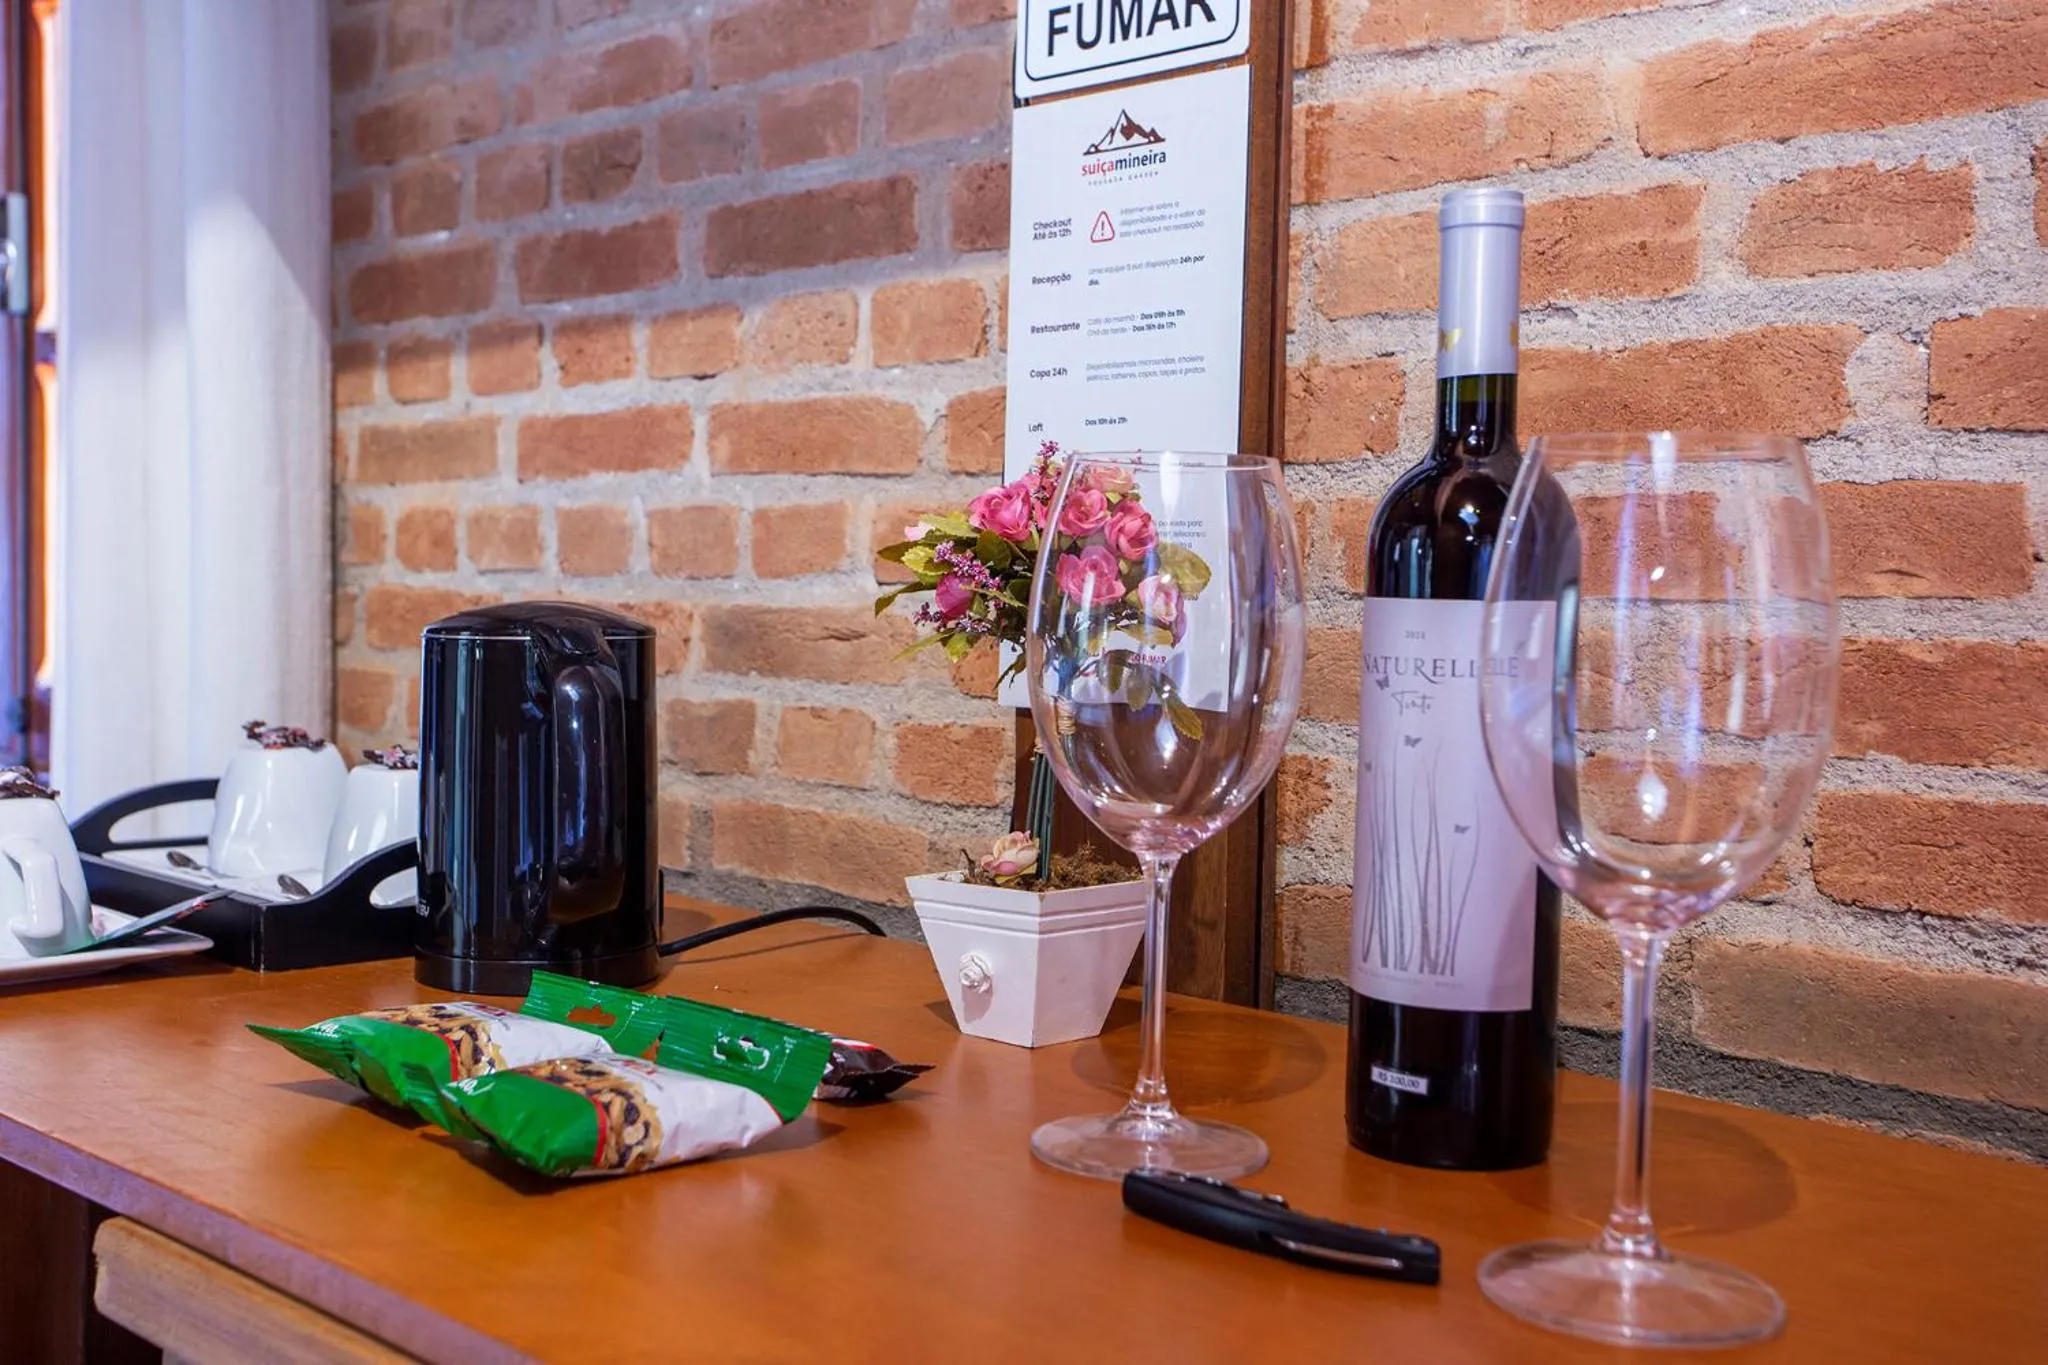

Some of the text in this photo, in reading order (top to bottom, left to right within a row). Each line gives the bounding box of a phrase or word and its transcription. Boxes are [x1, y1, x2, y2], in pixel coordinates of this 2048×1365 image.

[1048, 0, 1216, 57] FUMAR
[1082, 149, 1166, 176] suiçamineira
[1033, 218, 1072, 231] Checkout
[1032, 273, 1071, 286] Recepção
[1031, 322, 1081, 335] Restaurante
[1030, 367, 1068, 381] Copa 24h
